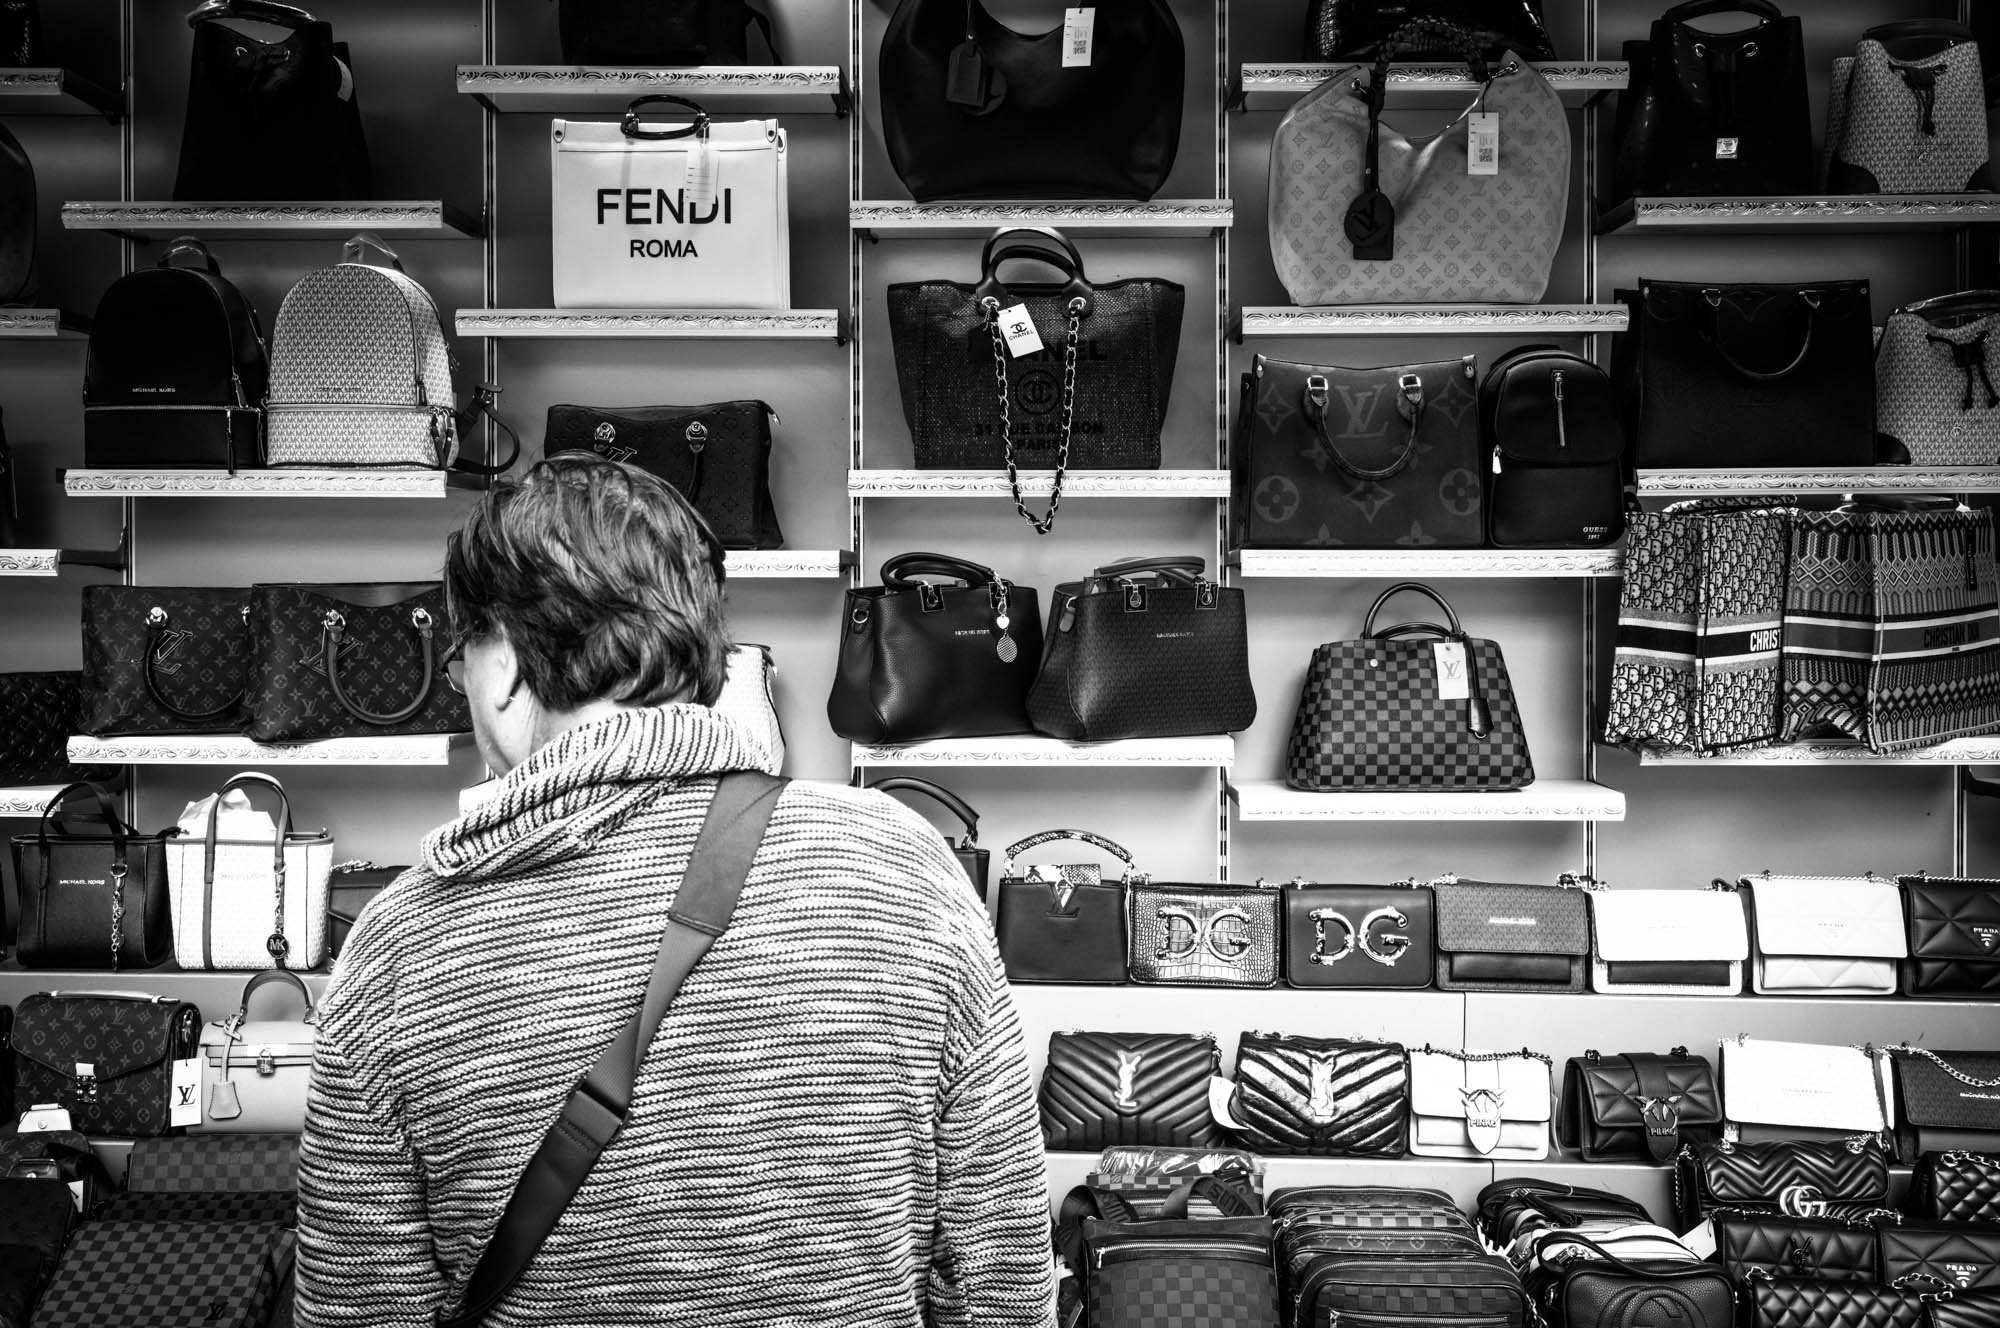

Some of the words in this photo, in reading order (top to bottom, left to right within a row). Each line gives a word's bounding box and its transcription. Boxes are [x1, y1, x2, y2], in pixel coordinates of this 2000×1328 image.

[597, 187, 730, 225] FENDI
[630, 239, 698, 258] ROMA
[1008, 329, 1035, 341] CHANEL
[1016, 438, 1060, 450] PARIS
[1923, 624, 1966, 649] CHRISTIAN
[1155, 904, 1251, 964] DG
[1308, 906, 1410, 966] DG
[1973, 926, 1999, 934] PRADA
[269, 938, 287, 951] MK
[1470, 1118, 1497, 1128] PINKO
[1650, 1127, 1677, 1137] PINKO
[1946, 1264, 1978, 1272] PRADA
